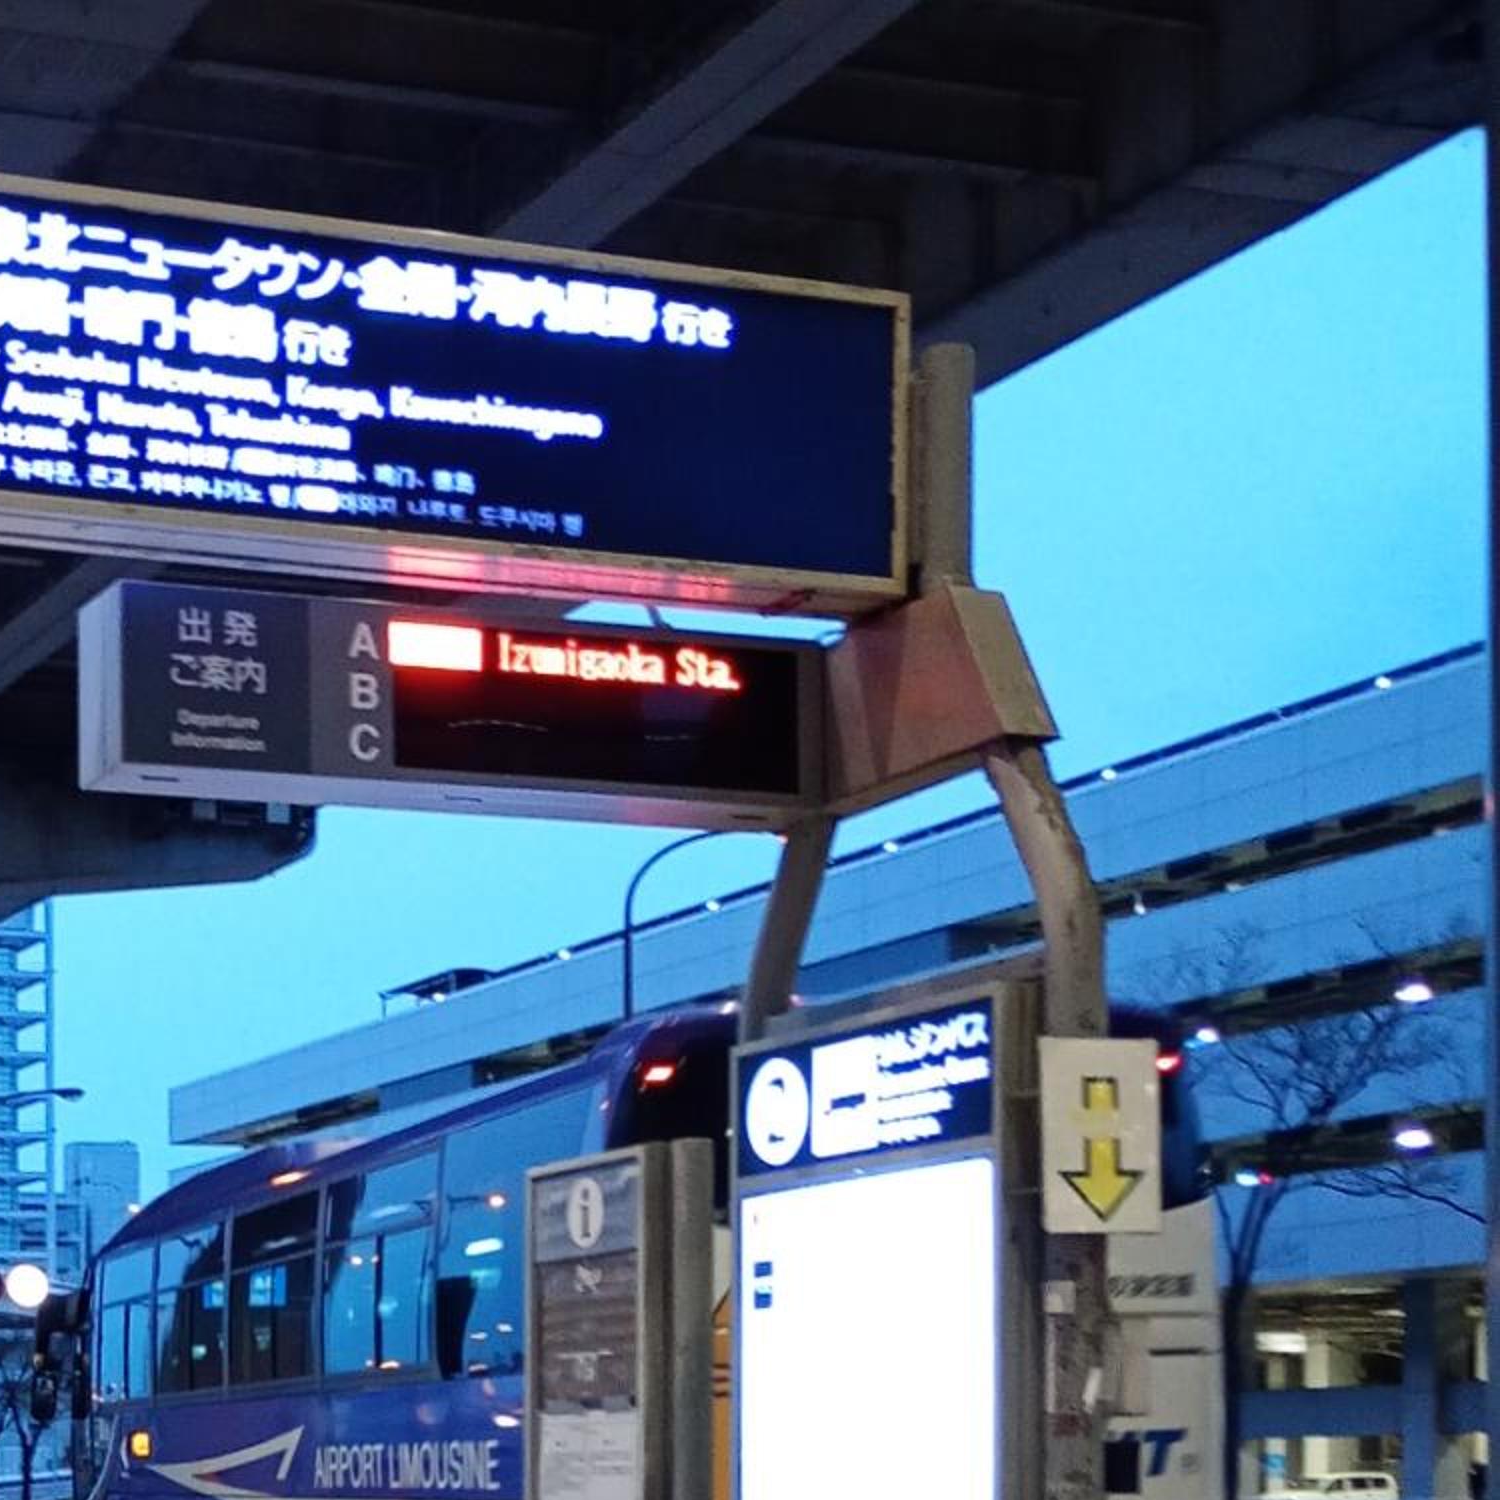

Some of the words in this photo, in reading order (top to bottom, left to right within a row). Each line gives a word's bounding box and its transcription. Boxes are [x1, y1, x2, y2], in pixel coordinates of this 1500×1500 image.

[176, 606, 259, 647] 出発
[348, 621, 380, 661] A
[169, 651, 267, 695] ご案内
[348, 672, 380, 710] B
[348, 722, 381, 762] C
[313, 1442, 384, 1489] AIRPORT
[387, 1439, 501, 1491] LIMOUSINE
